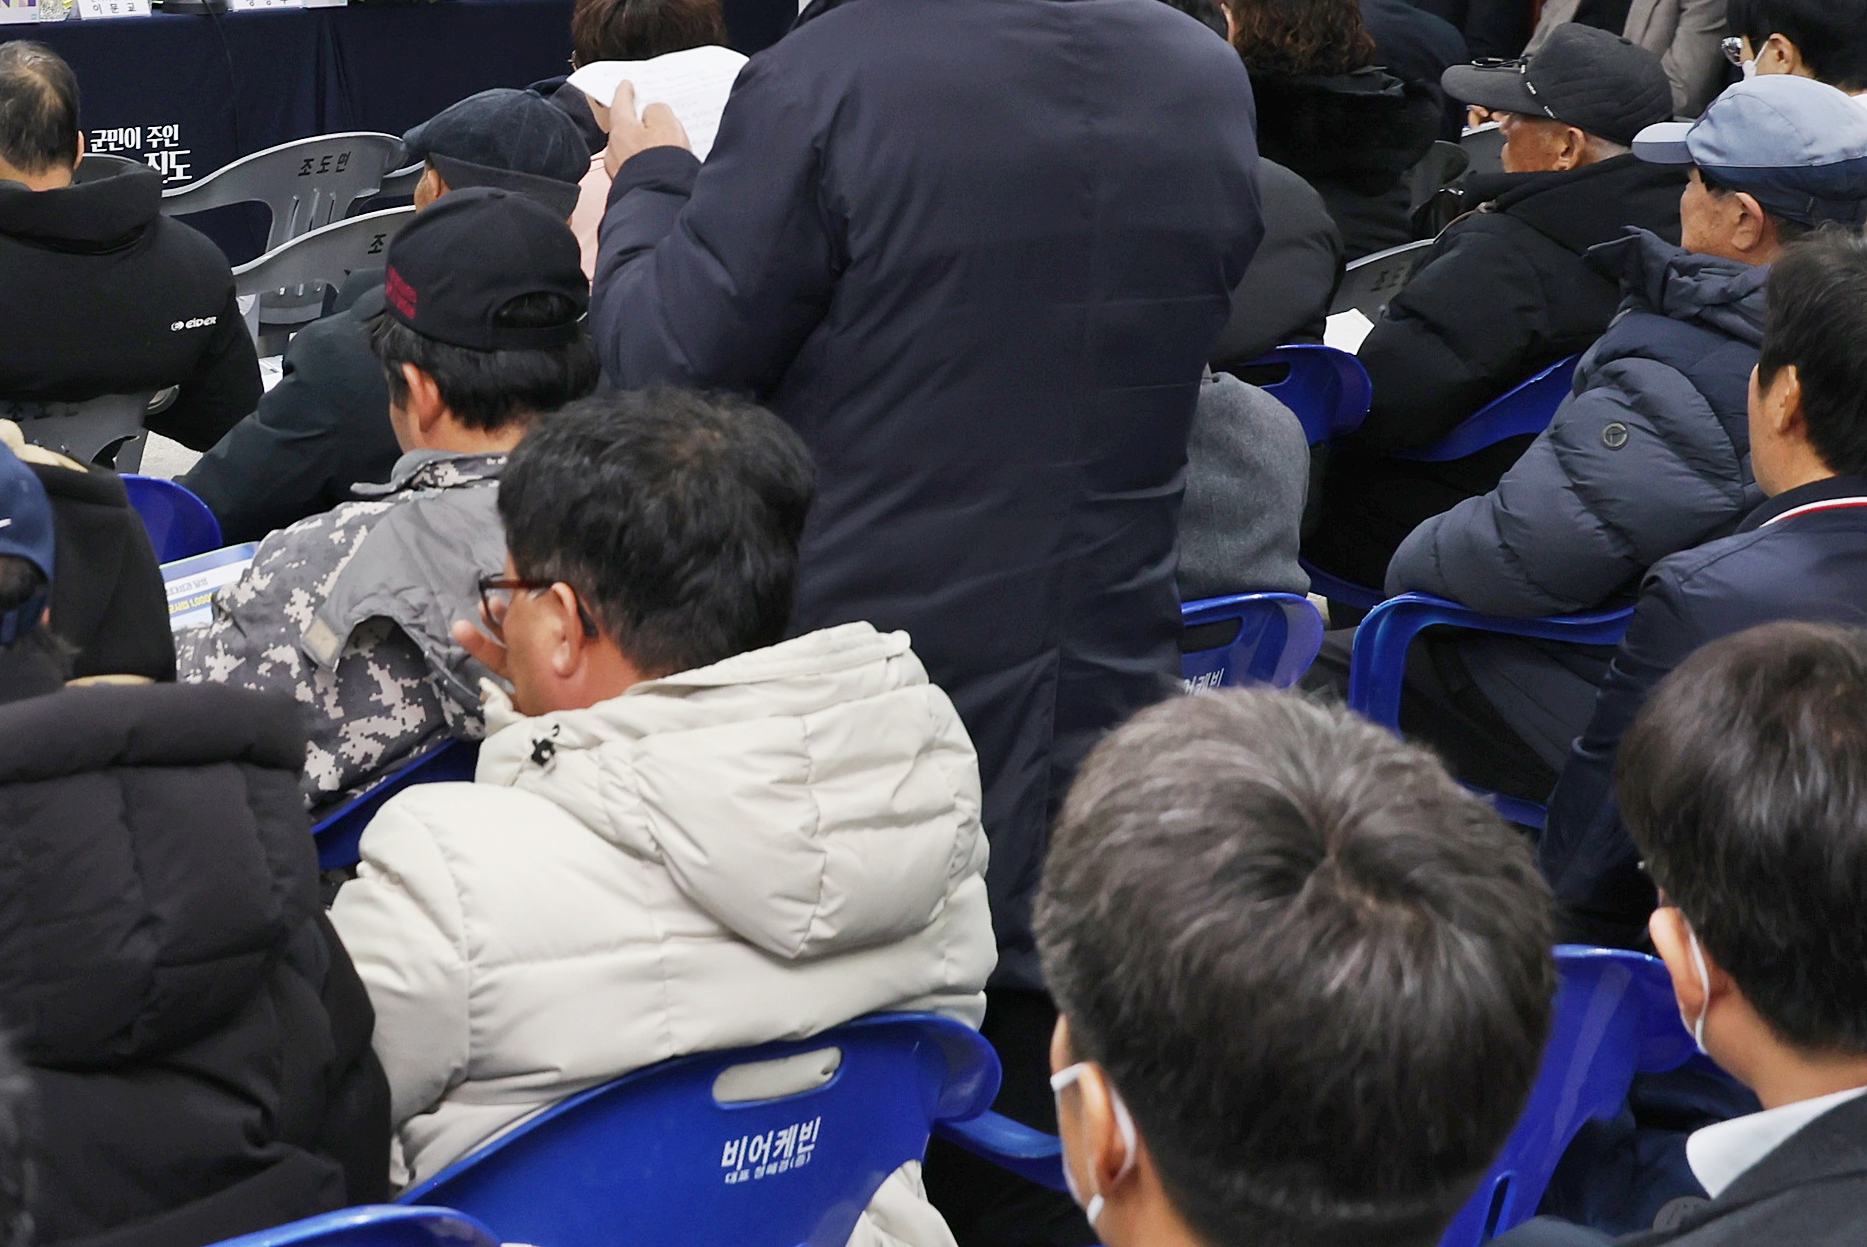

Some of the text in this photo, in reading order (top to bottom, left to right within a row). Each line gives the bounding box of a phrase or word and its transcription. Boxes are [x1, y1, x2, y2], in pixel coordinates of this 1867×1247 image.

[89, 124, 179, 152] 군민이 주인
[298, 151, 351, 177] 조도면
[721, 1116, 821, 1171] 비어케빈
